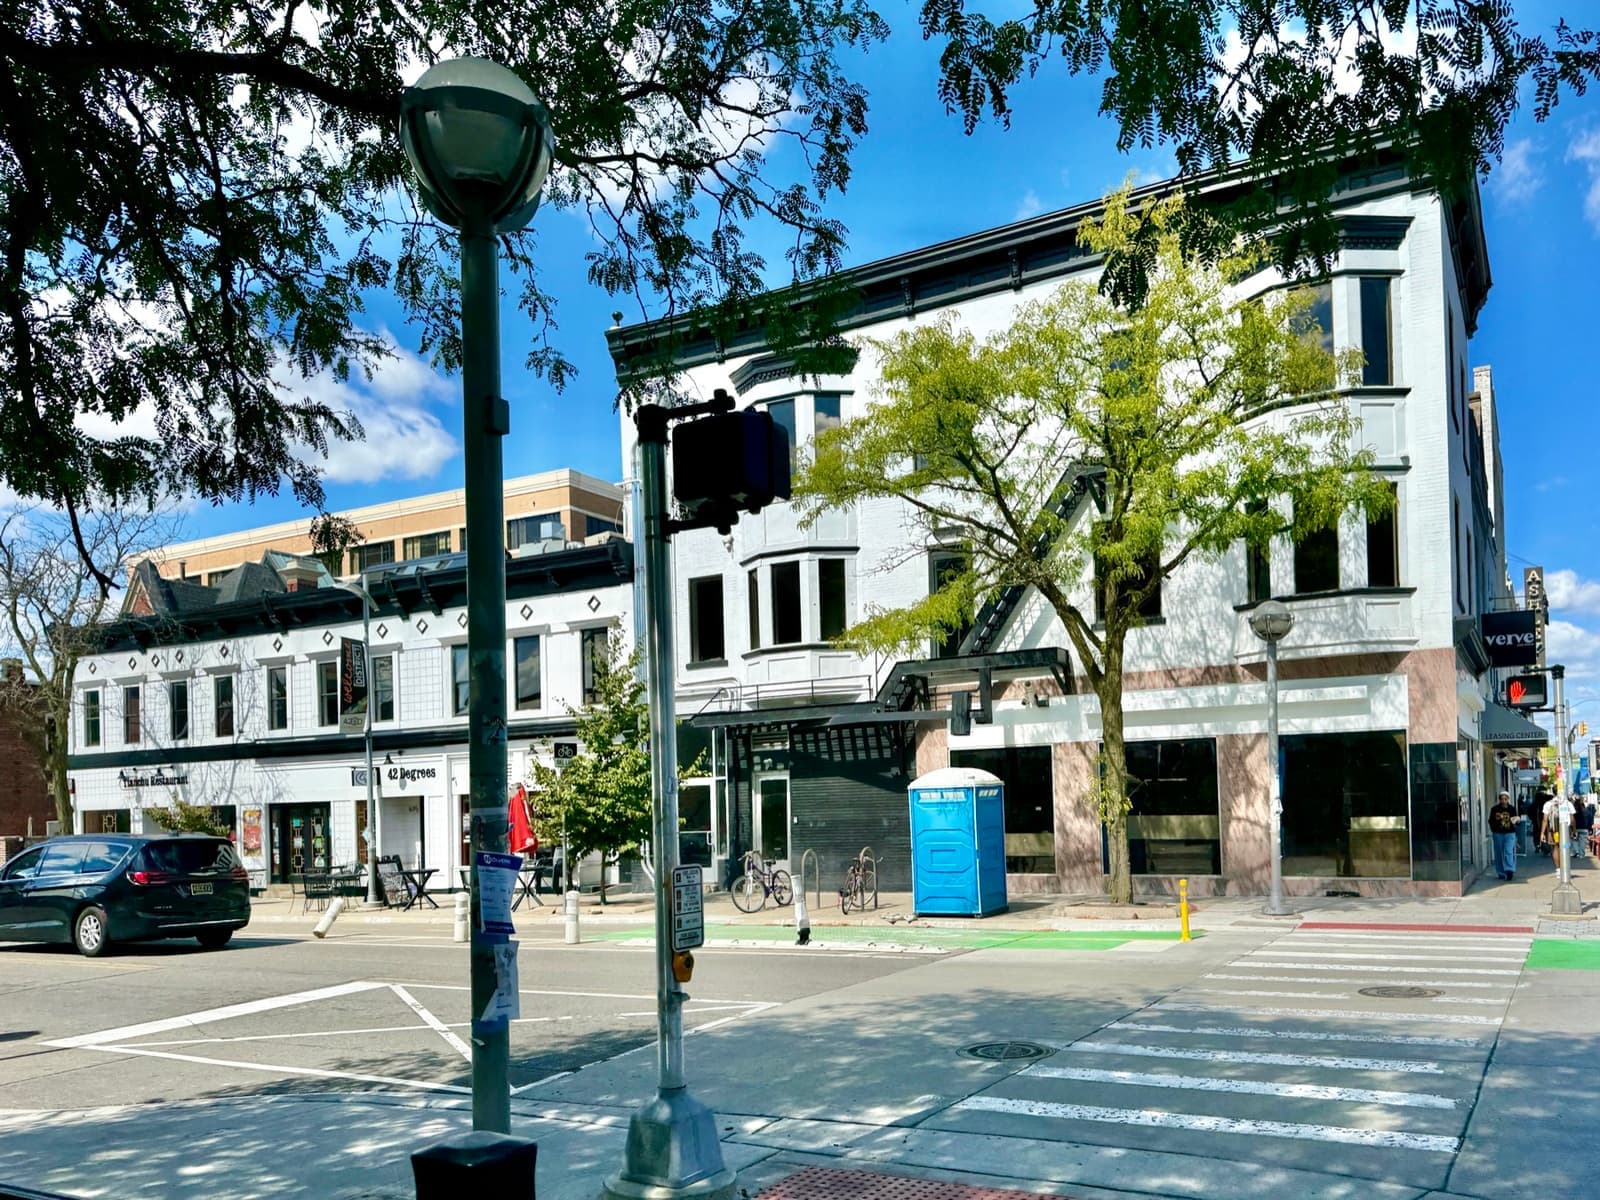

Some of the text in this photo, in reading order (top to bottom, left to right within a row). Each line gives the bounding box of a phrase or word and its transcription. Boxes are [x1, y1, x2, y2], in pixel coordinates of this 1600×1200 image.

[1485, 632, 1534, 646] verve
[354, 646, 364, 686] DISTRICT
[1515, 731, 1543, 739] CENTER
[387, 767, 436, 782] 42 Degrees
